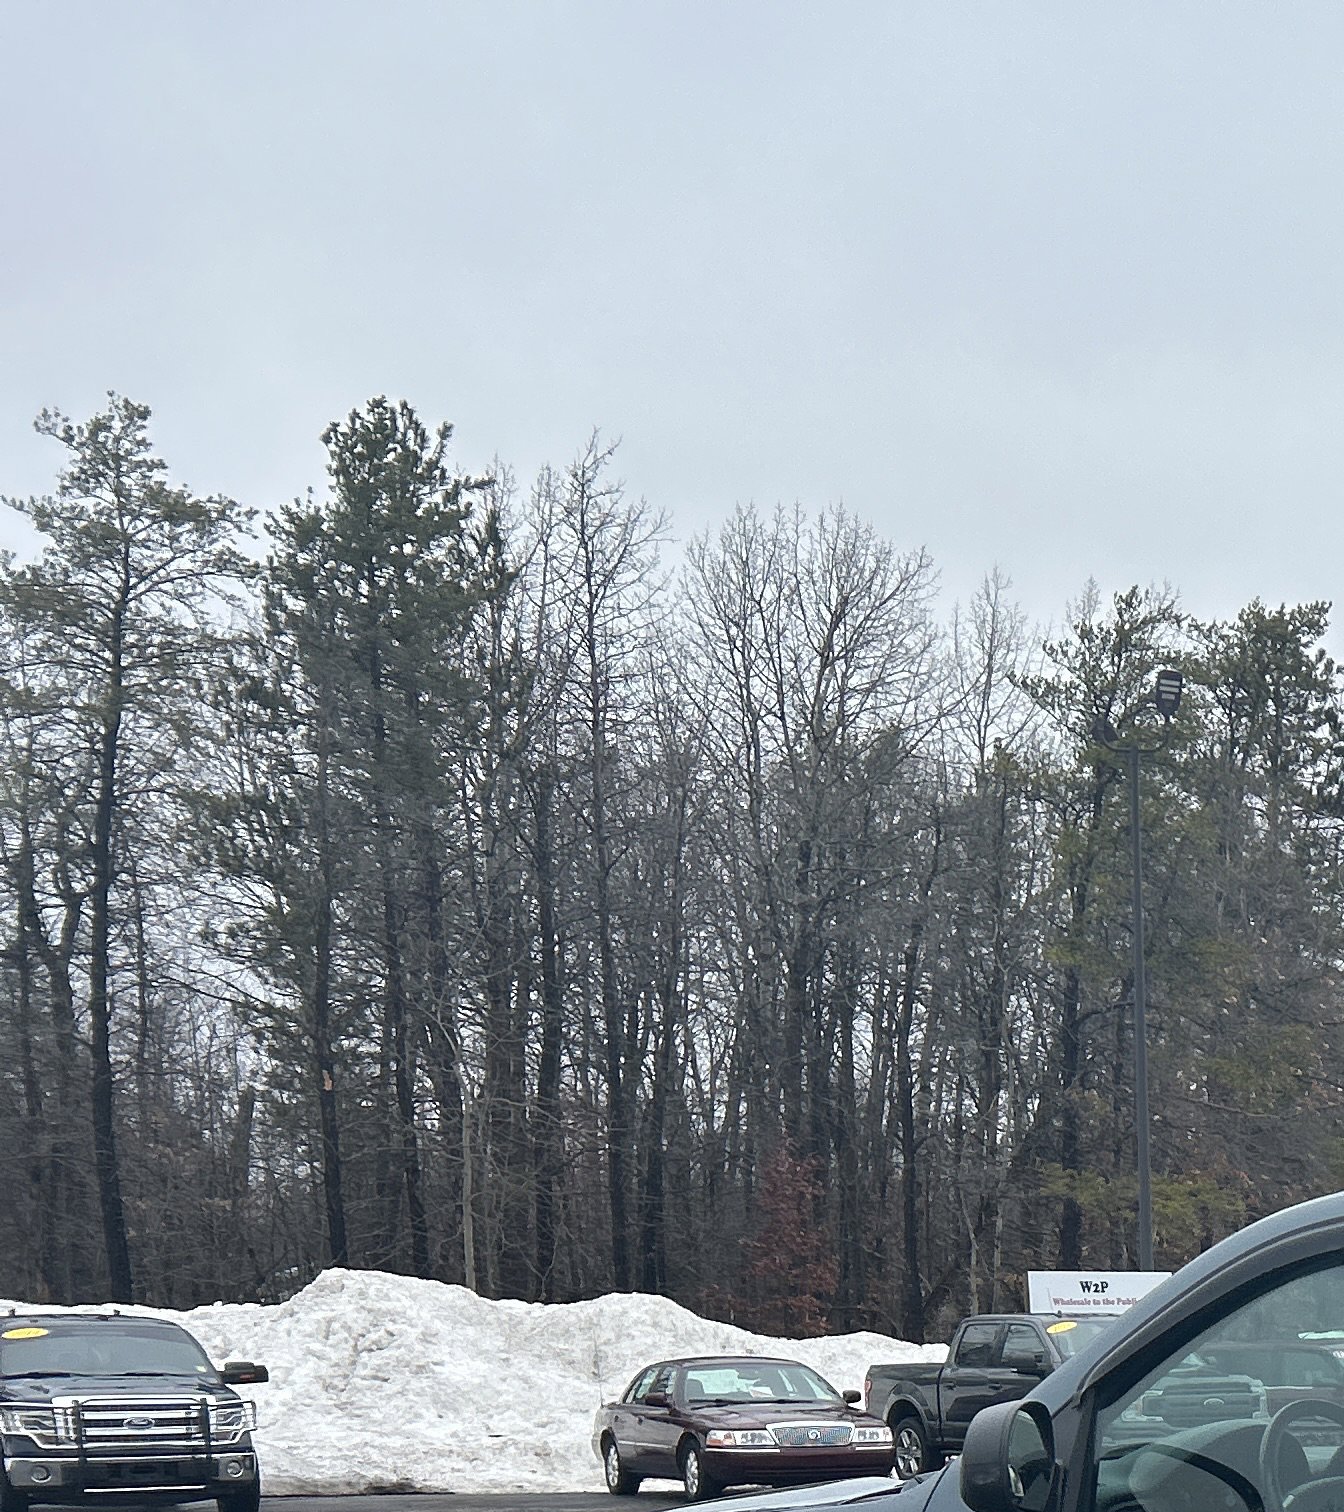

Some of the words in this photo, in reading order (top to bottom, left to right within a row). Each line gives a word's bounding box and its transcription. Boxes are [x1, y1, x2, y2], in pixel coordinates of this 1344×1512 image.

[1079, 1281, 1109, 1293] W2P
[1052, 1297, 1091, 1305] Wholesale
[1103, 1297, 1115, 1305] the
[1116, 1297, 1137, 1306] Publi
